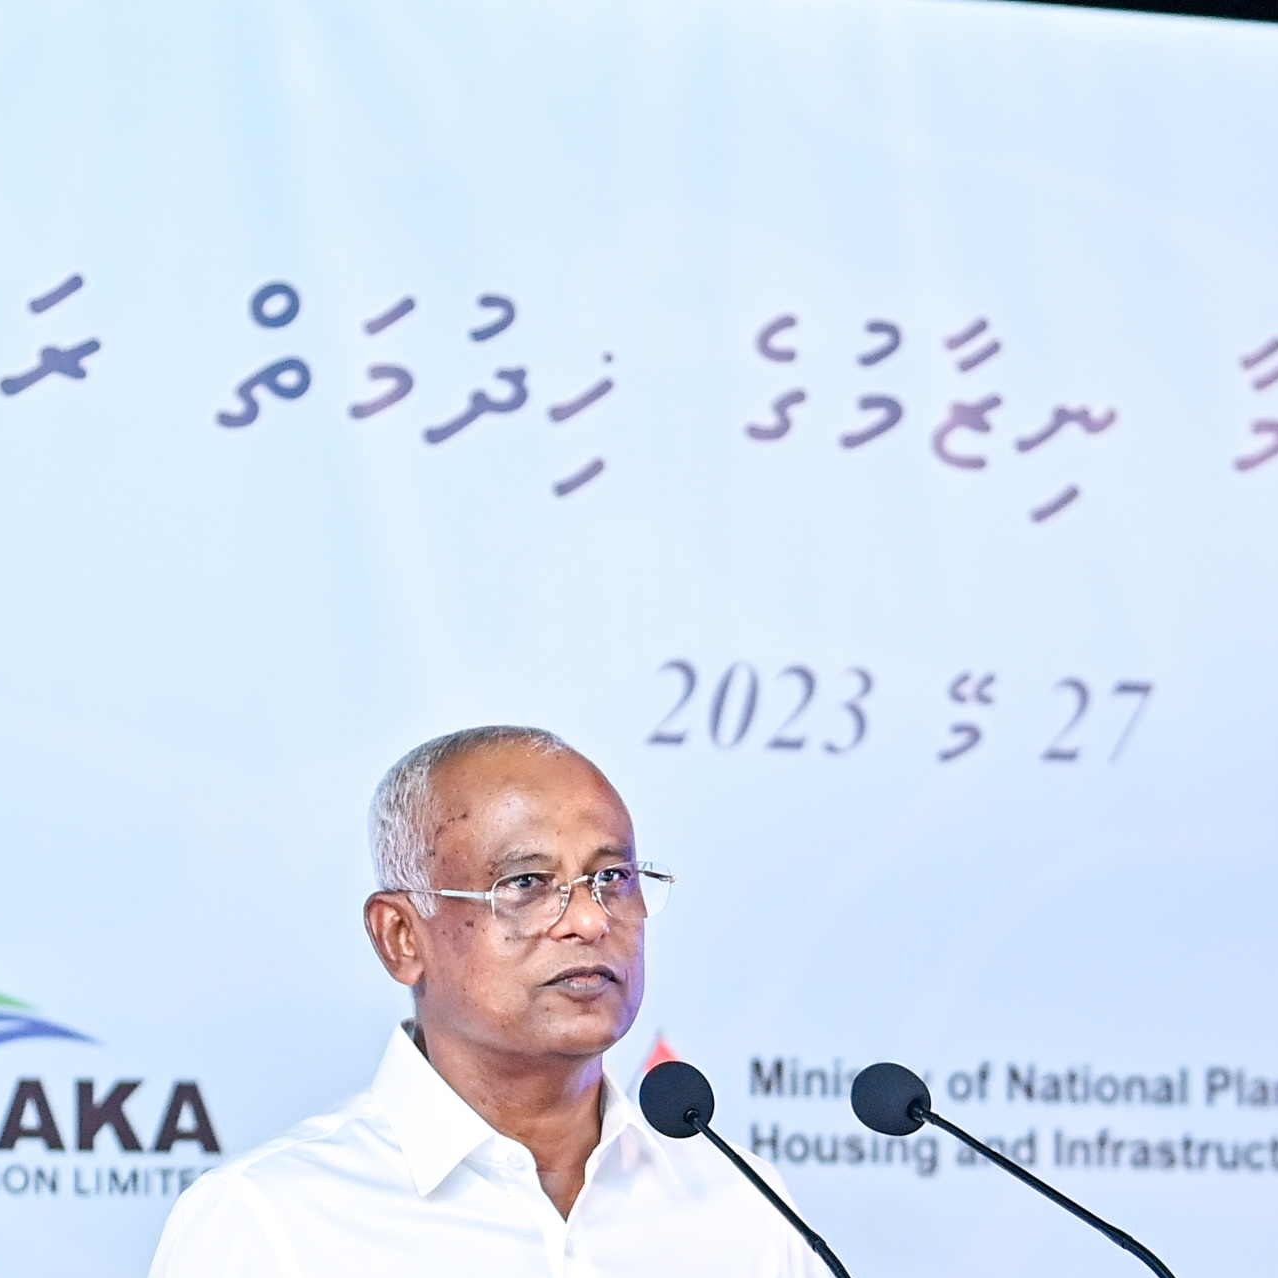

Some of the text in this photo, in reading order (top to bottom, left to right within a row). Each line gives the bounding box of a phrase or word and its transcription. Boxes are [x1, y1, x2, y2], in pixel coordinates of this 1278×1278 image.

[744, 314, 1118, 524] ނިޒާމުގެ
[646, 657, 1154, 765] 27 މޭ 2023
[946, 1060, 990, 1102] of
[1006, 1062, 1189, 1105] National
[750, 1122, 939, 1178] Housing
[73, 1166, 214, 1197] LIMITE
